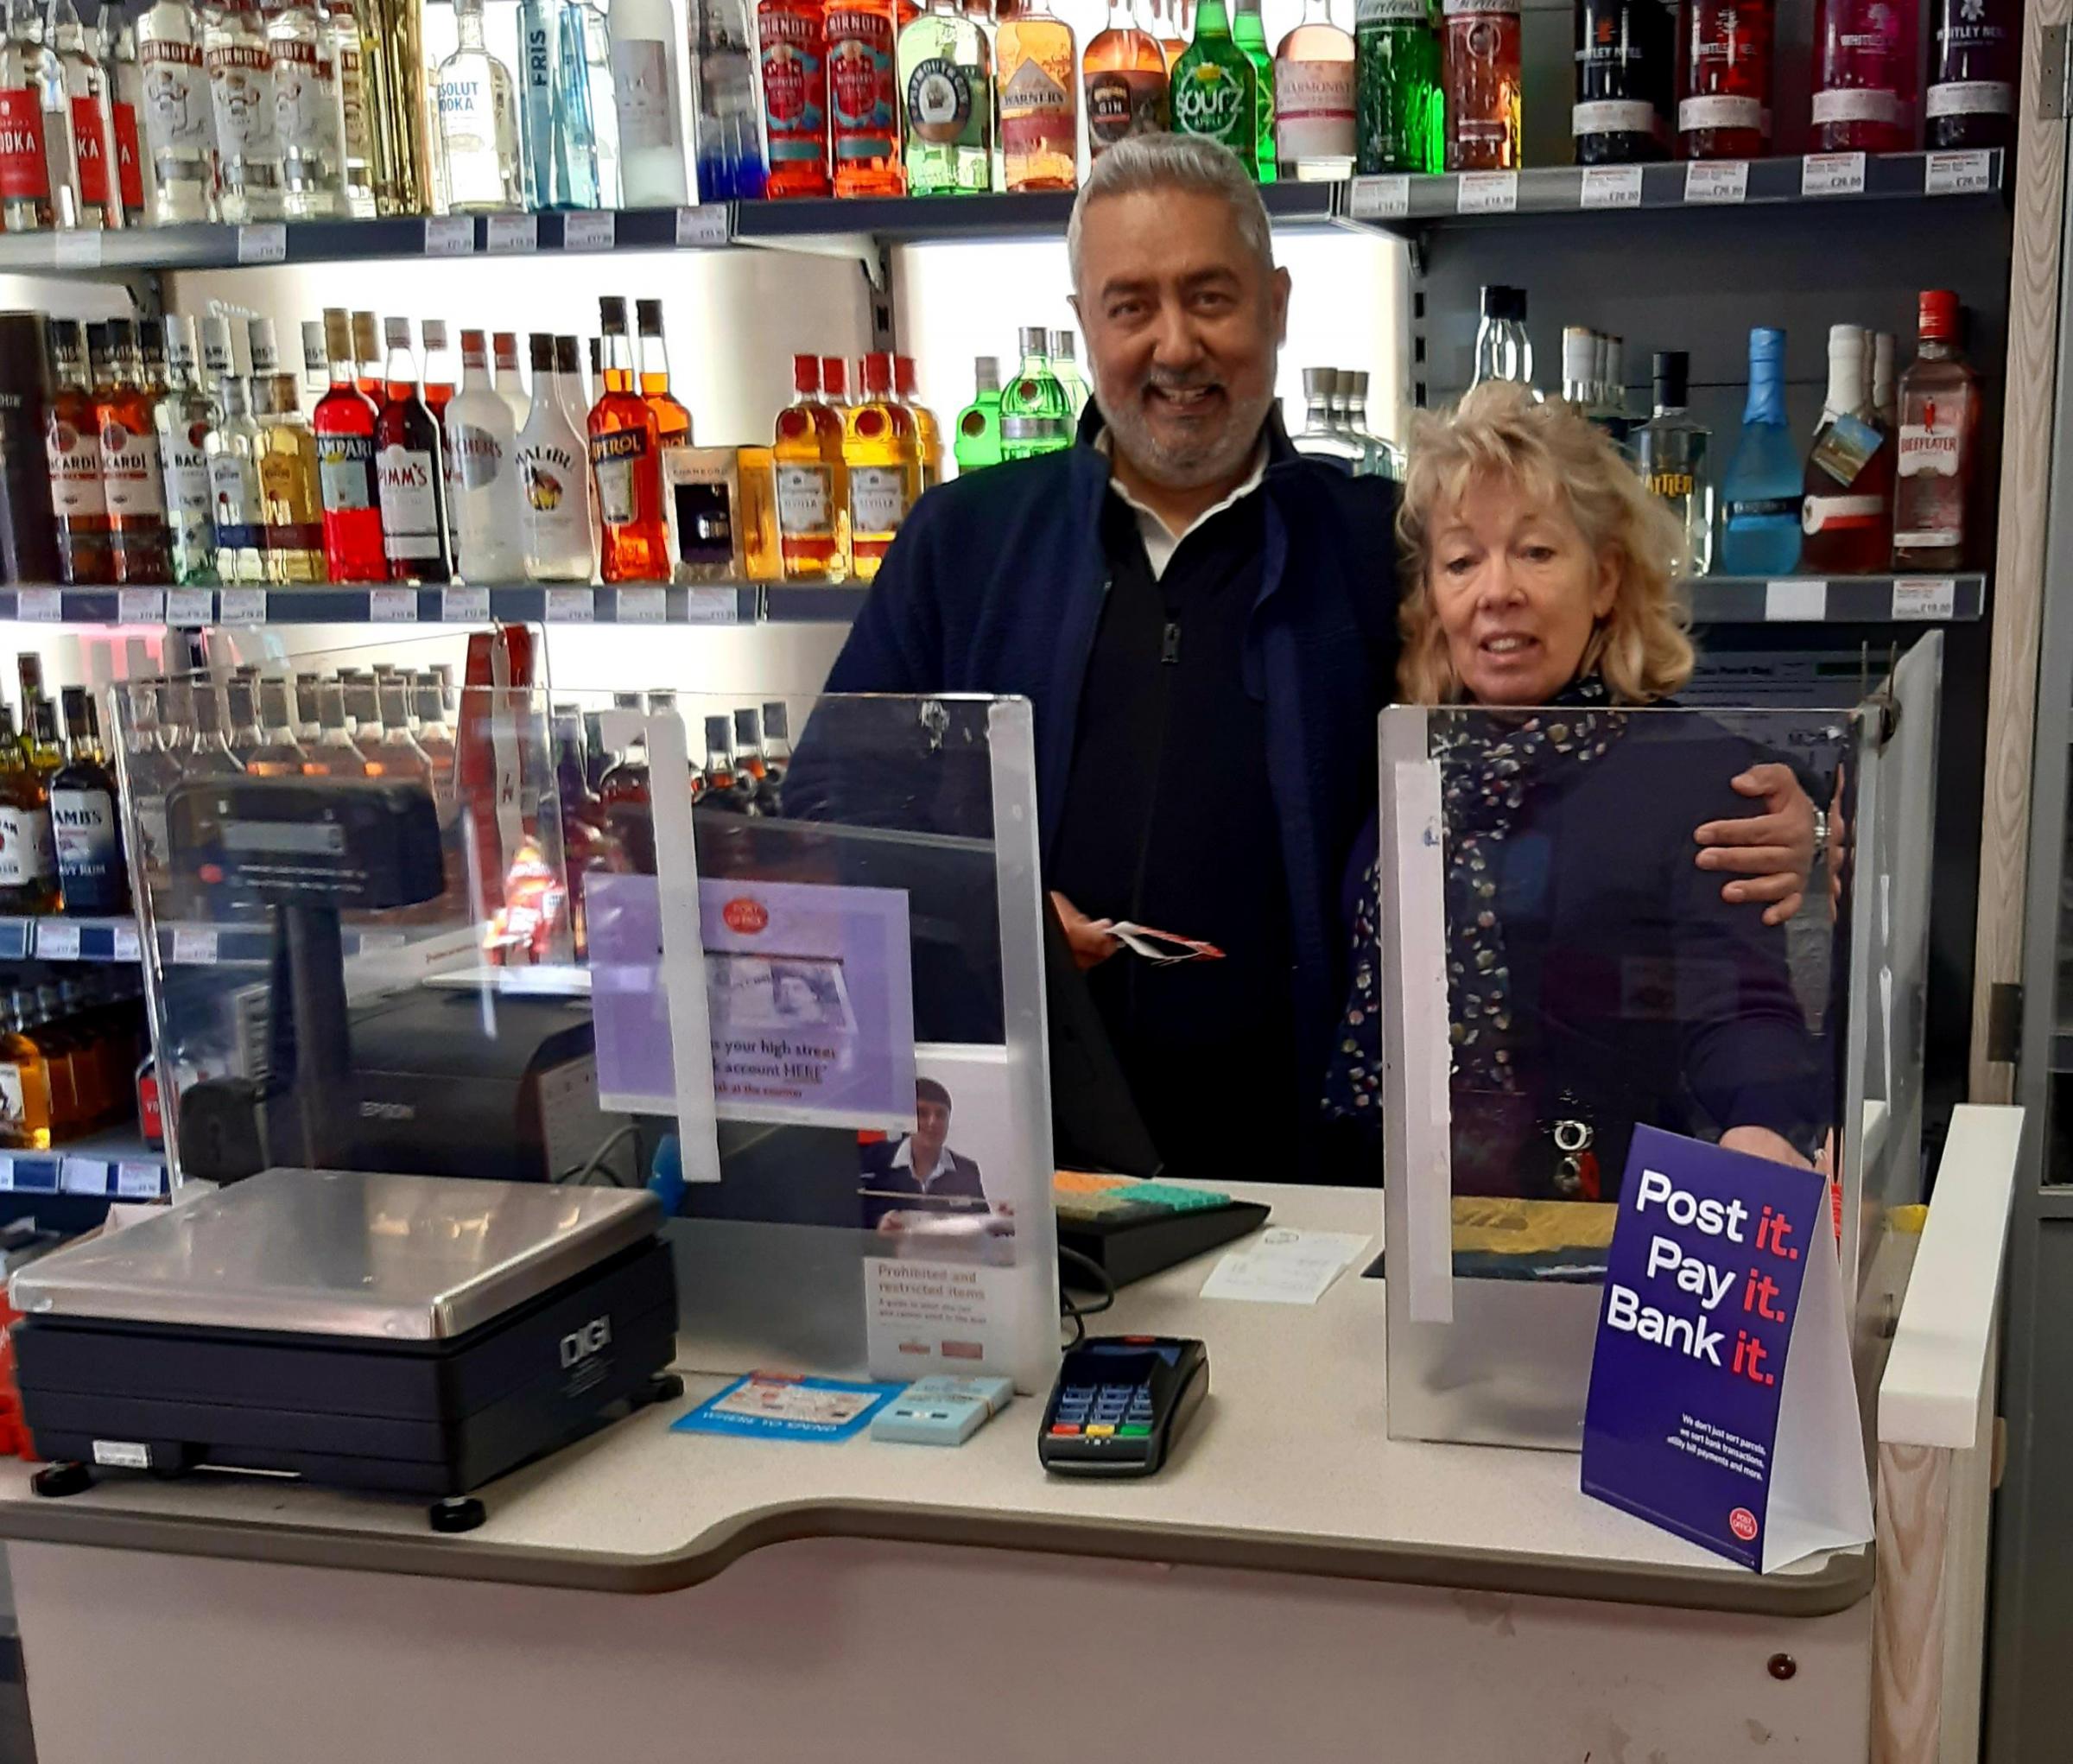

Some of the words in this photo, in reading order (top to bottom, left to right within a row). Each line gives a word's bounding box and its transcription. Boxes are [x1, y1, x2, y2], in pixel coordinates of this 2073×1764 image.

[530, 29, 548, 86] FRIS
[1901, 437, 1956, 453] BEEFEATER
[726, 1041, 756, 1056] your
[761, 1039, 792, 1059] high
[796, 1044, 836, 1060] street
[726, 1063, 781, 1076] account
[1636, 1169, 1748, 1243] Post
[1755, 1206, 1798, 1260] it.
[878, 1264, 948, 1281] Prohibited
[952, 1272, 977, 1284] and
[1646, 1235, 1737, 1310] Pay
[1743, 1268, 1786, 1323] it.
[878, 1282, 943, 1296] restricted
[948, 1286, 986, 1300] items
[1607, 1283, 1726, 1367] Bank
[1732, 1329, 1774, 1386] it.
[1682, 1412, 1694, 1427] We
[1696, 1447, 1729, 1468] payments
[1729, 1460, 1744, 1473] and
